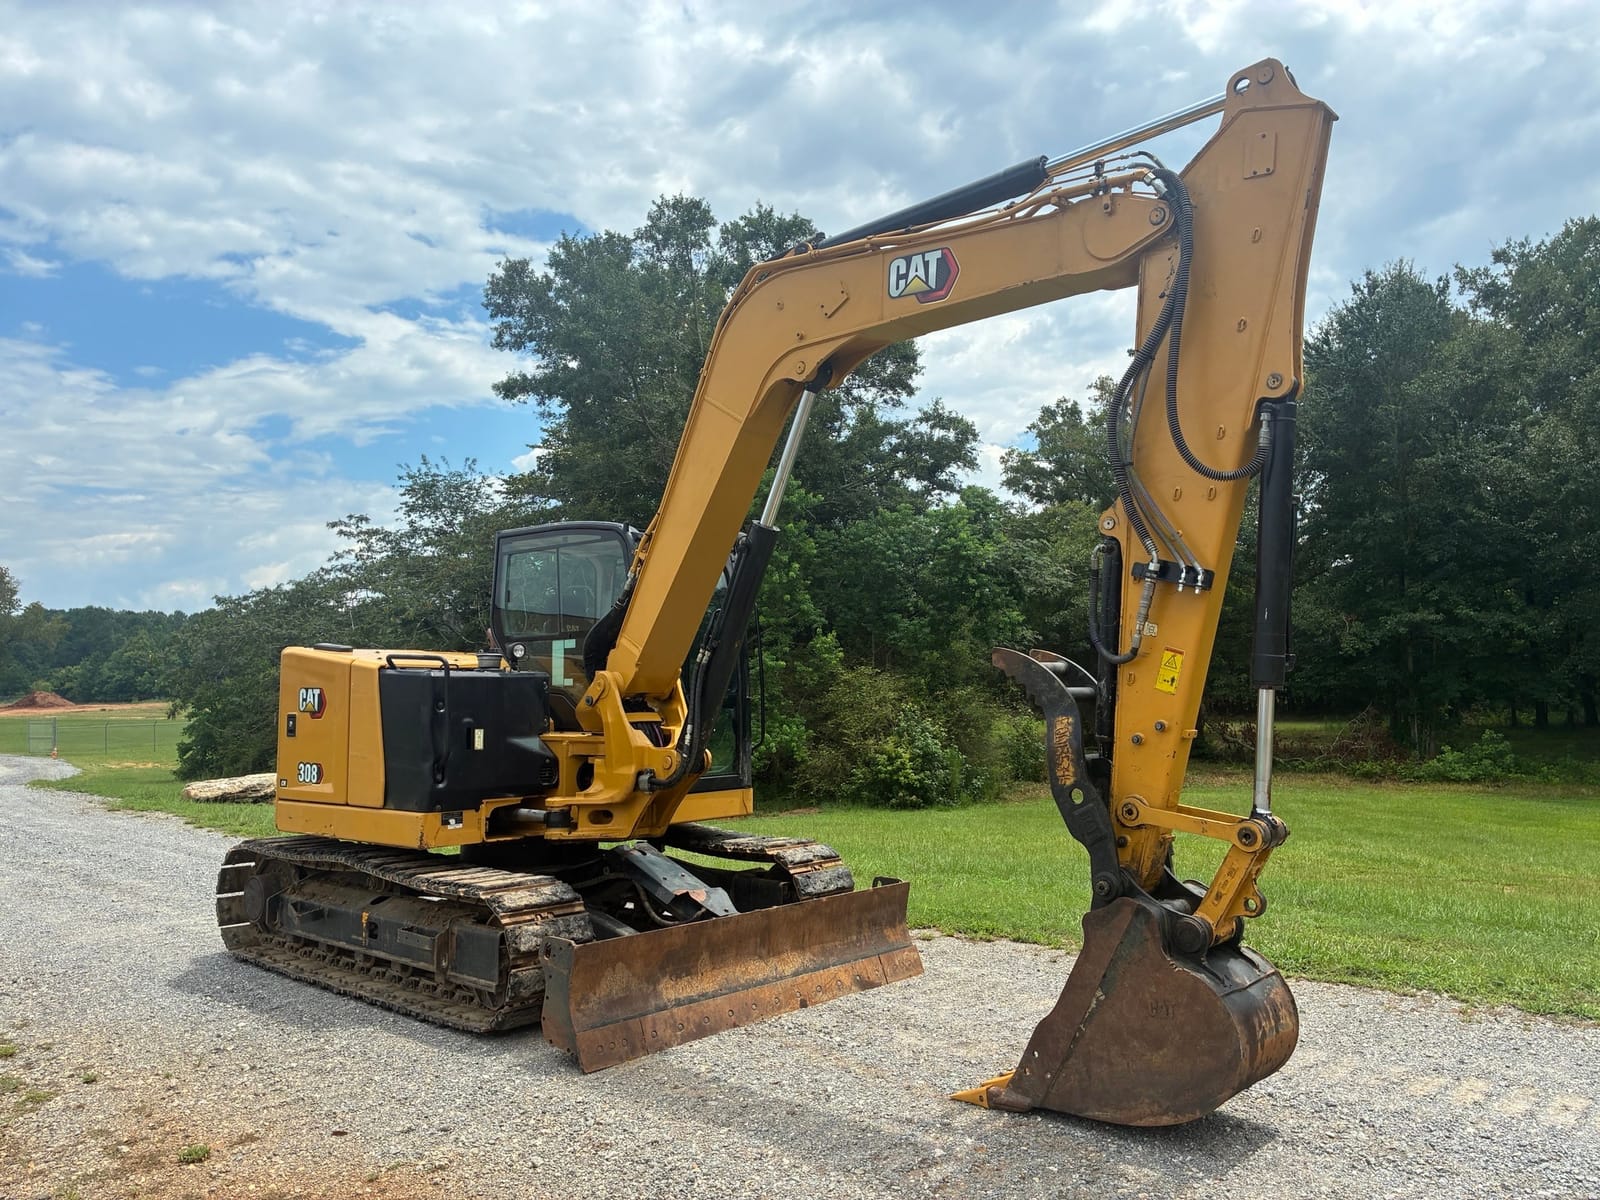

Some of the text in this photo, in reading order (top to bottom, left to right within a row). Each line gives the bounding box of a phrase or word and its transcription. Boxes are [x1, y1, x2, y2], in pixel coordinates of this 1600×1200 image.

[889, 249, 942, 298] CAT
[299, 688, 321, 712] CAT
[298, 763, 318, 783] 308
